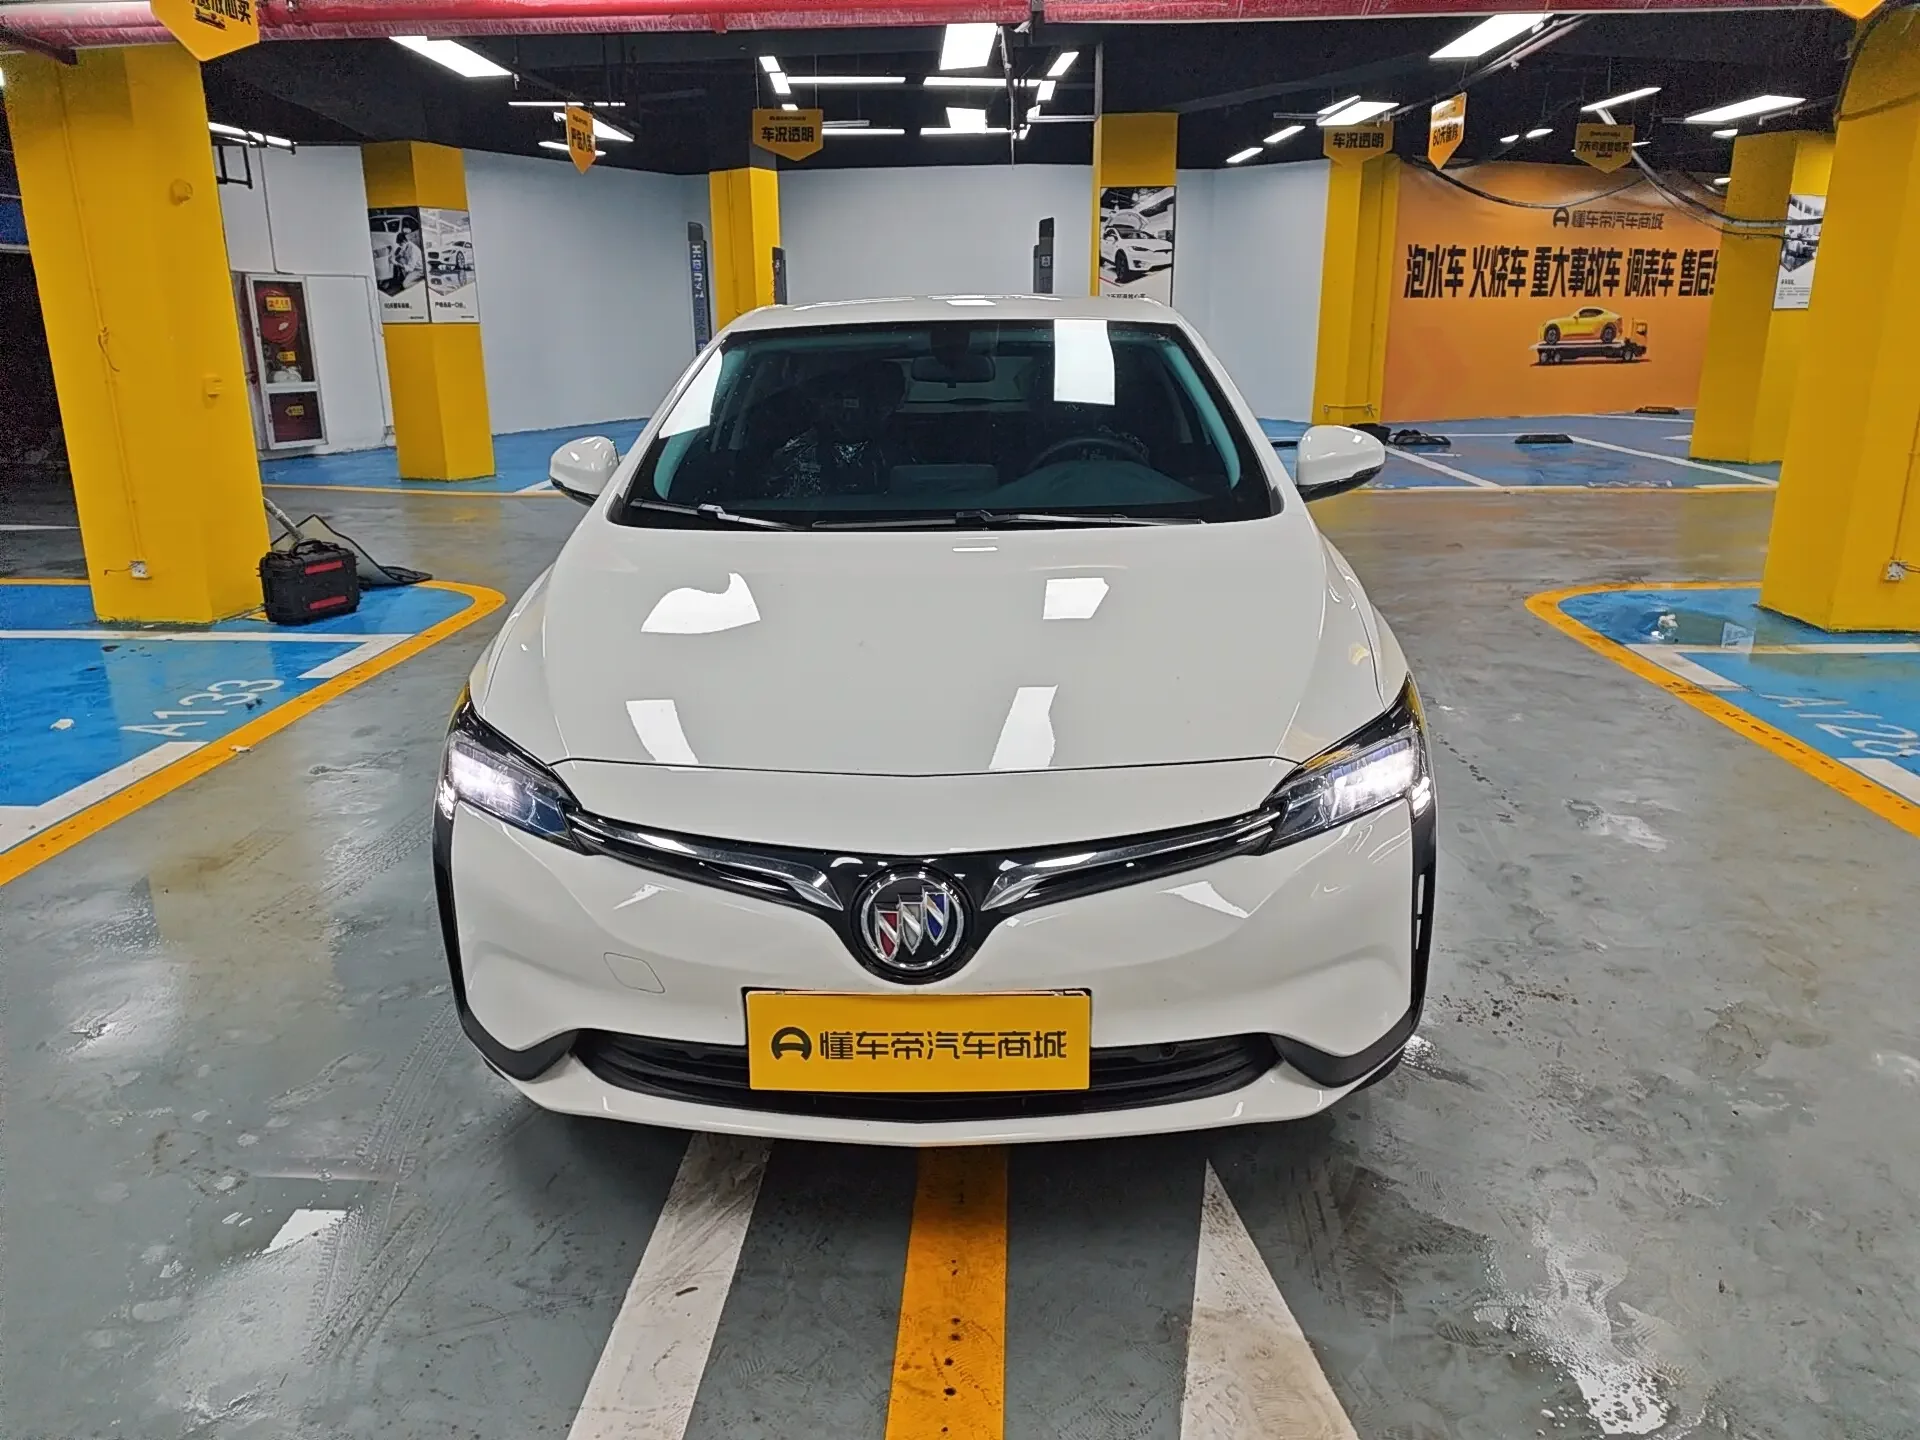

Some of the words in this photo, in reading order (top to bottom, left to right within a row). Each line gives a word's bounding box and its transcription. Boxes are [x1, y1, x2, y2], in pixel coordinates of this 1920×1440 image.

[761, 126, 815, 142] 车况透明
[1333, 132, 1384, 148] 车况透明
[1403, 244, 1466, 298] 泡水车
[1469, 245, 1529, 297] 火烧车
[1530, 246, 1623, 297] 重大事故车
[1624, 248, 1677, 297] 调表车
[119, 679, 285, 736] A133
[820, 1031, 1067, 1060] 懂车帝汽车商城
